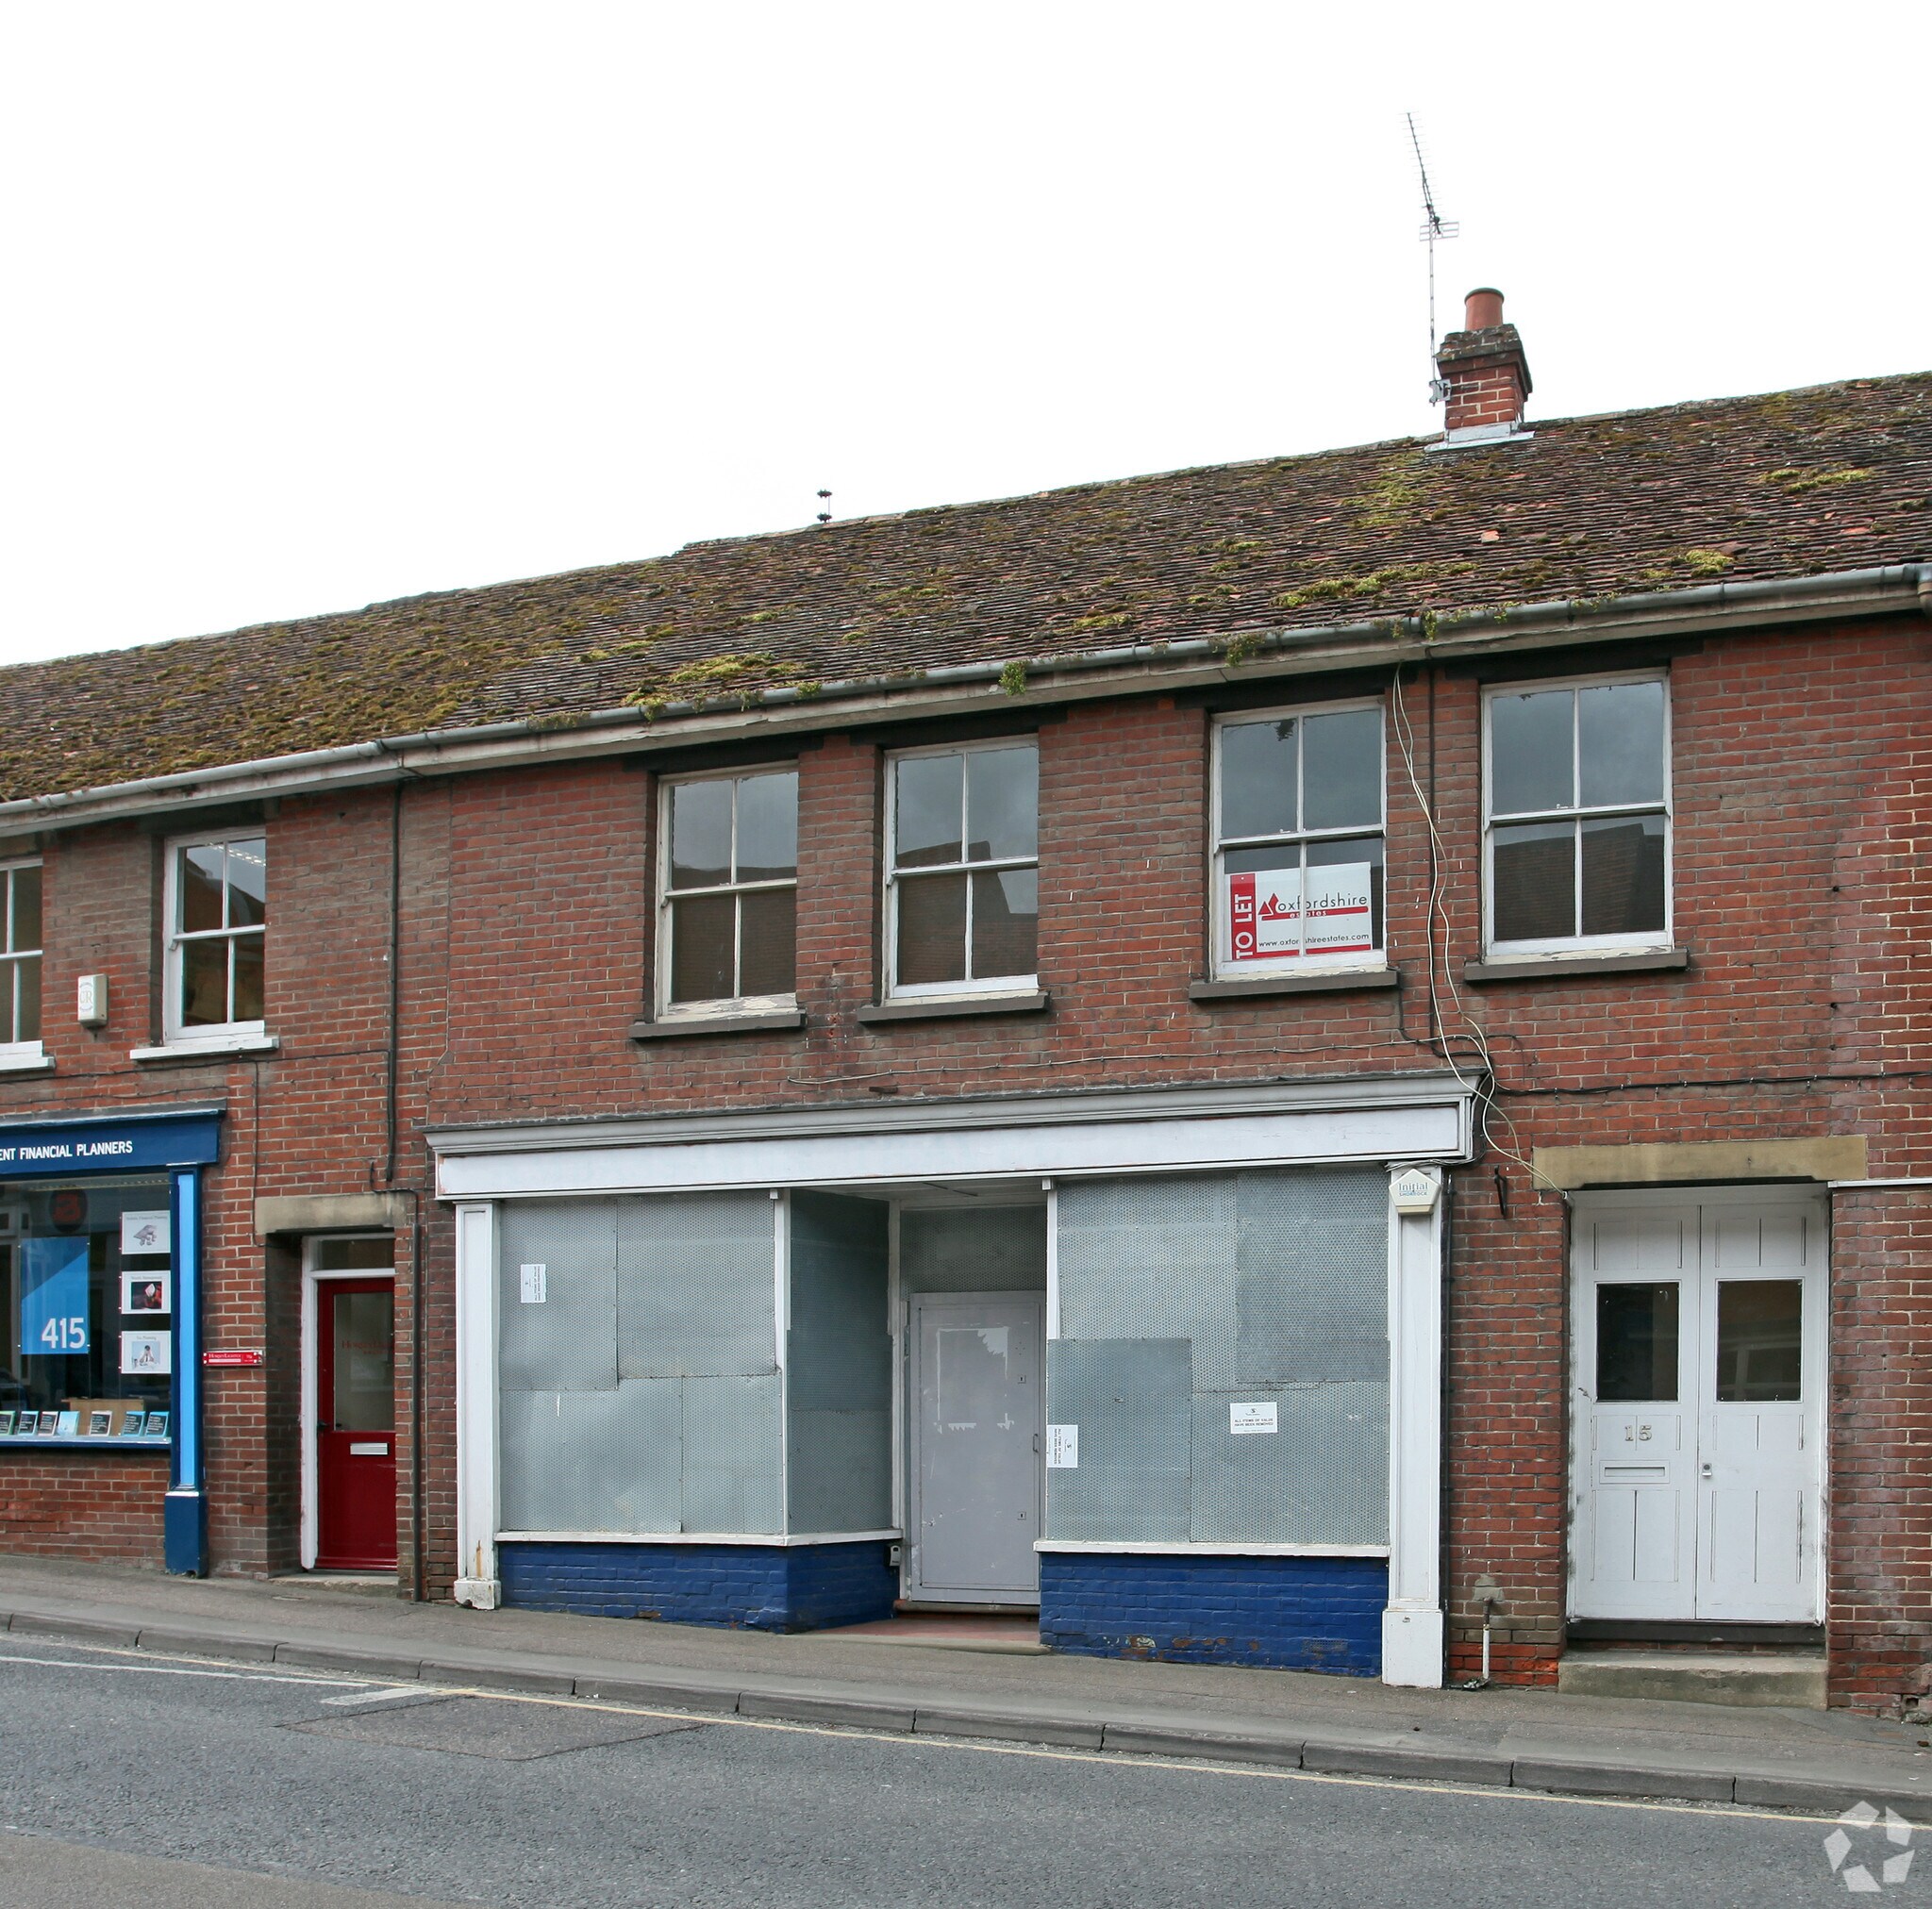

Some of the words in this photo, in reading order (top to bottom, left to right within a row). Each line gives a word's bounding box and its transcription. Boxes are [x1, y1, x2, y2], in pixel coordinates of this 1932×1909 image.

[1234, 893, 1253, 923] LET
[1289, 909, 1327, 919] esates
[1235, 931, 1254, 959] TO
[20, 1144, 73, 1160] FINANCIAL
[76, 1140, 133, 1156] PLANNERS
[1398, 1182, 1428, 1191] Initial
[42, 1317, 86, 1349] 415
[1624, 1424, 1652, 1441] 15
